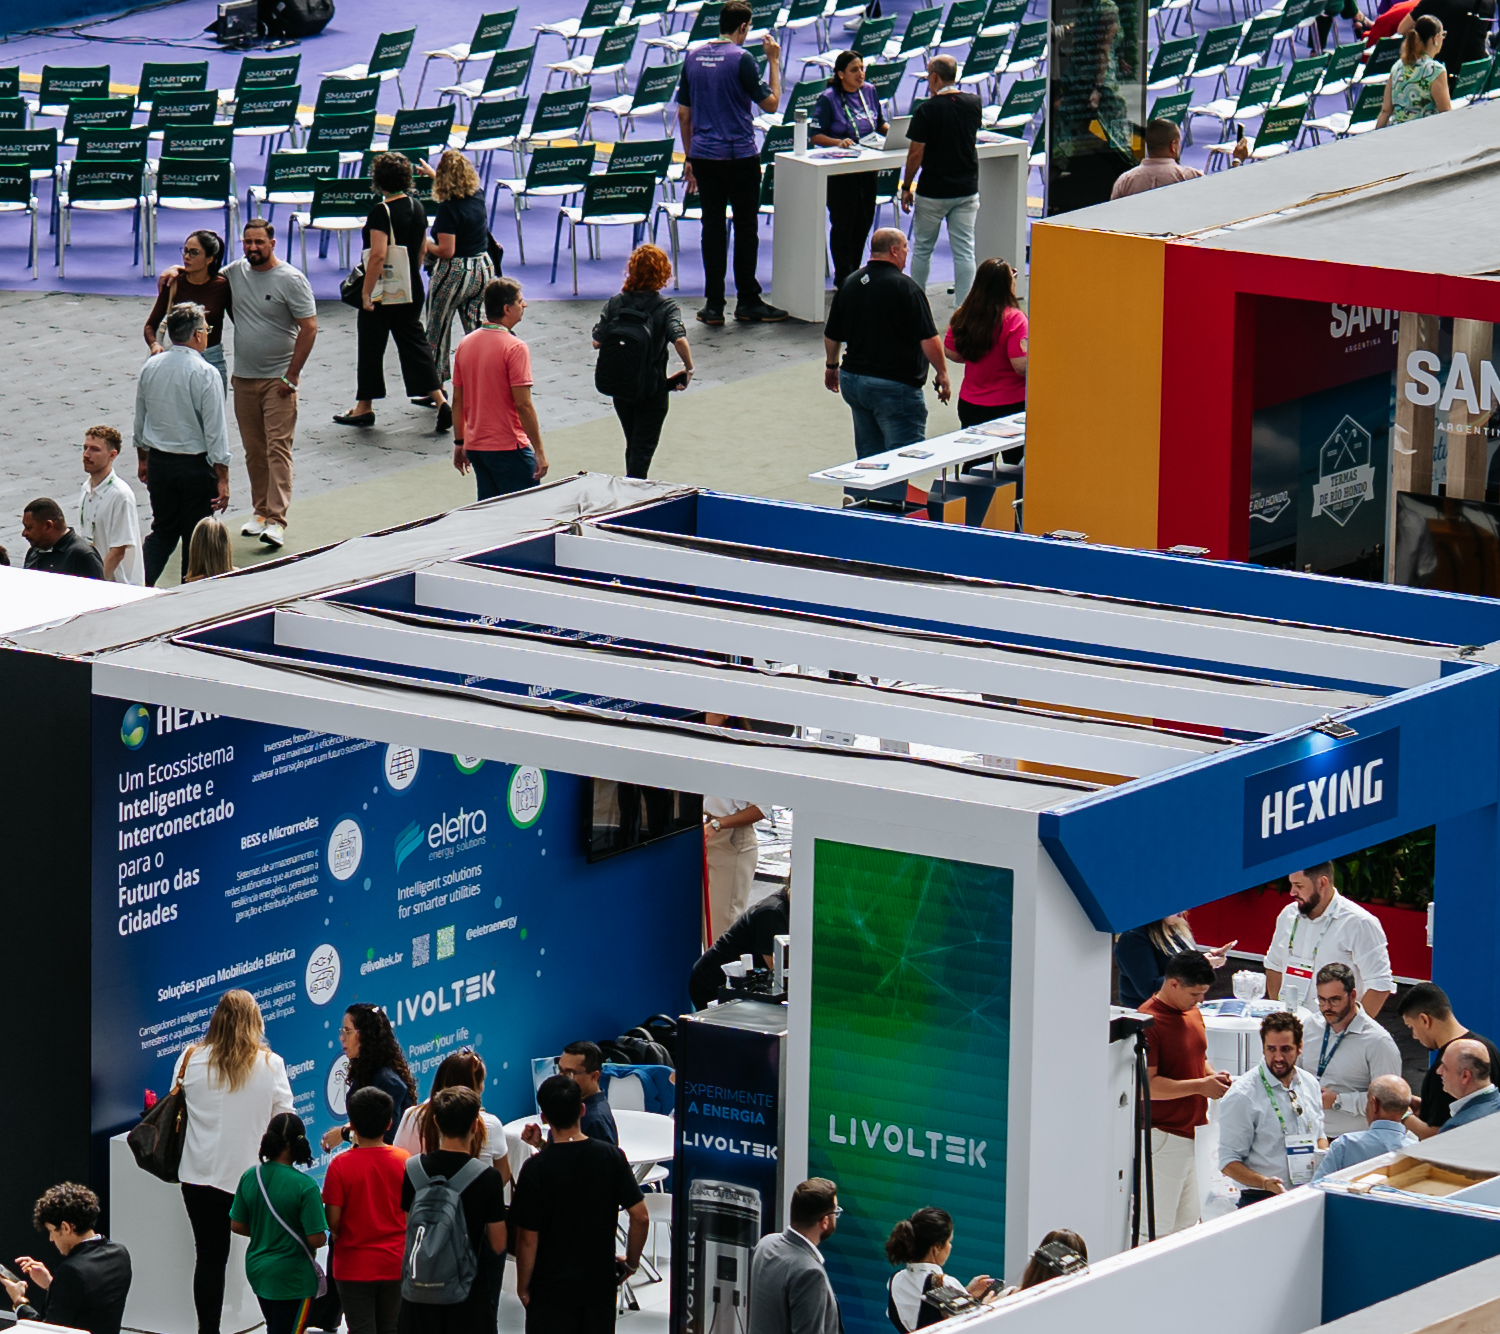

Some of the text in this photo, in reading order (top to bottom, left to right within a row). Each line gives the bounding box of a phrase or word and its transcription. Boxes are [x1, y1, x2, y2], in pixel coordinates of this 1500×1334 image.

[77, 172, 134, 182] SMARTCITY
[594, 185, 648, 196] SMARTCITY
[1319, 493, 1329, 505] DE
[1344, 480, 1368, 500] HONDO
[1330, 470, 1358, 488] TERMAS
[119, 745, 234, 793] Um Ecossistema
[119, 780, 214, 822] Inteligente e
[1260, 758, 1385, 841] HEXING
[119, 799, 235, 851] Interconectado
[428, 807, 487, 849] eletra
[119, 851, 164, 885] para o
[397, 864, 482, 901] Intelligent solutions
[119, 867, 200, 908] Futuro das
[398, 882, 481, 920] for smarter utilities
[119, 903, 178, 936] Cidades
[684, 1081, 774, 1108] EXPERIMENTE
[702, 1102, 765, 1125] ENERGIA
[682, 1130, 778, 1160] LIVOLTEK
[829, 1114, 987, 1169] LIVOLTEK
